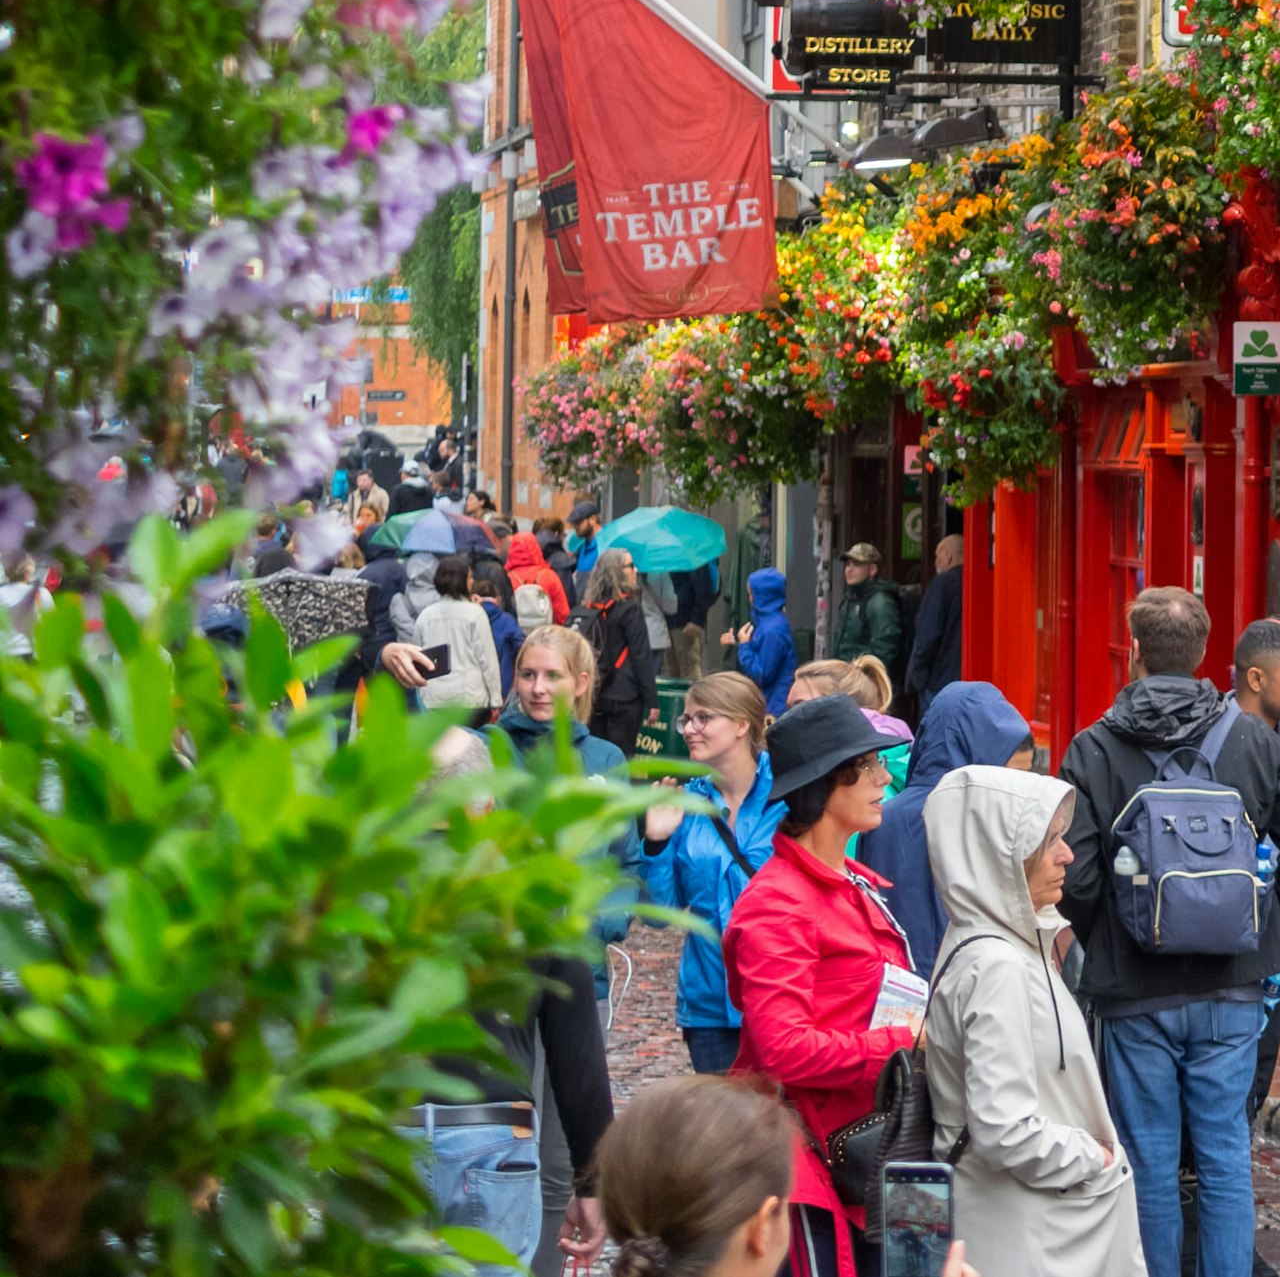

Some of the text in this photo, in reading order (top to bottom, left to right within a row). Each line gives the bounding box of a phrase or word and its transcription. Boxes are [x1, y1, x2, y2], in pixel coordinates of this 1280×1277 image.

[1021, 3, 1066, 19] USIC
[805, 36, 915, 55] DISTILLERY
[828, 68, 891, 84] STORE
[642, 180, 712, 208] THE
[596, 197, 763, 243] TEMPLE
[640, 236, 728, 271] BAR
